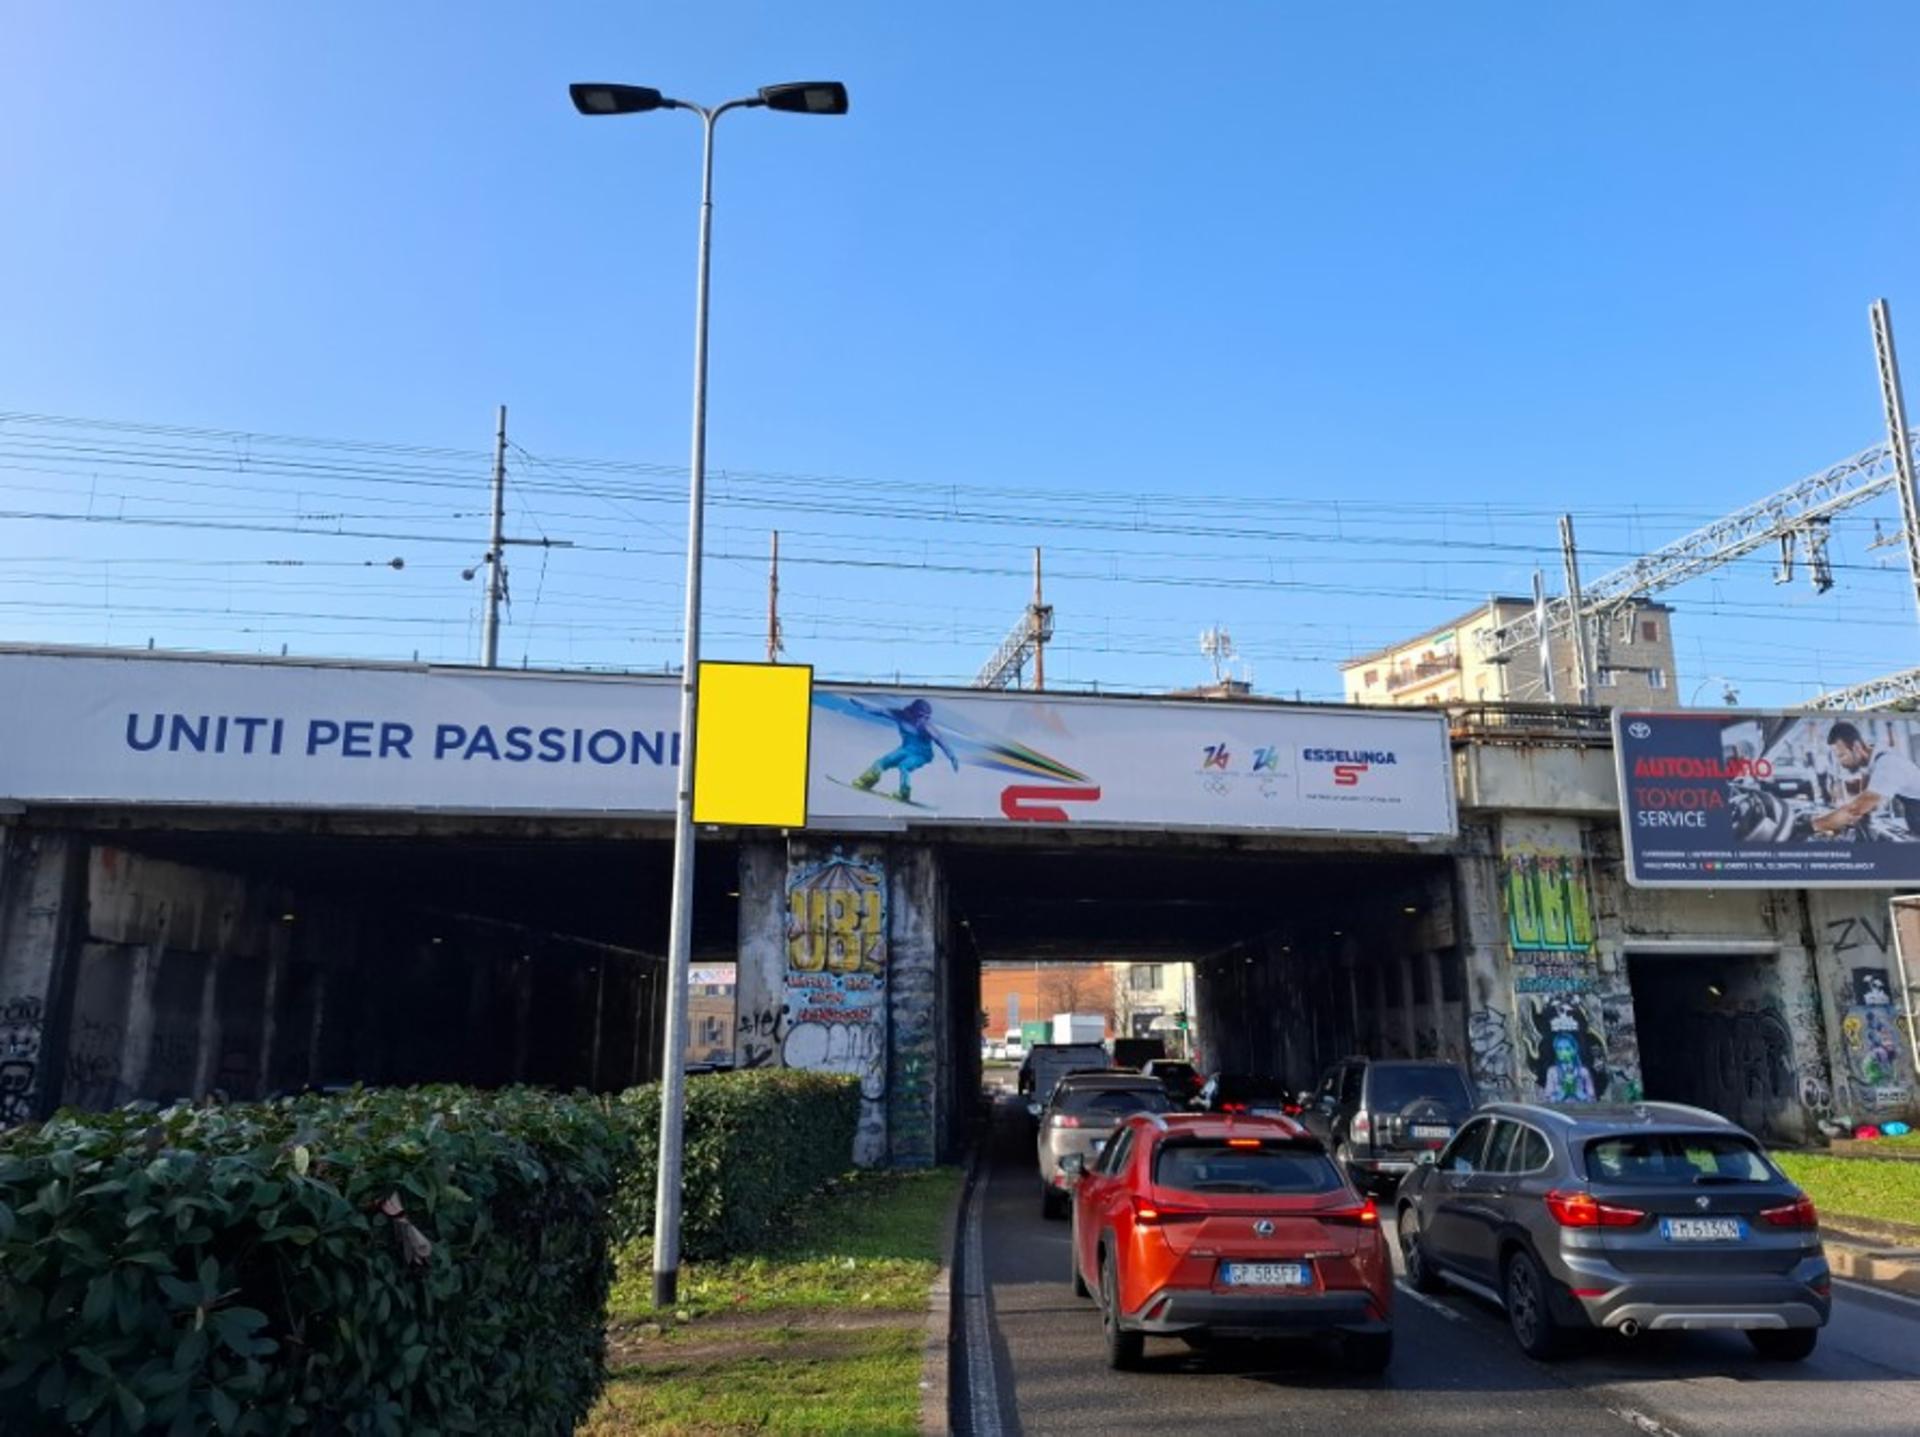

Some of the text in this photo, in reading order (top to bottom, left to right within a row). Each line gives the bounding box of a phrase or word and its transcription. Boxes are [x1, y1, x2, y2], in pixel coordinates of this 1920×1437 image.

[126, 713, 284, 755] UNITI
[306, 719, 414, 759] PER
[1303, 748, 1397, 765] ESSELUNGA
[1636, 787, 1724, 809] TOYOTA
[1637, 810, 1707, 828] SERVICE
